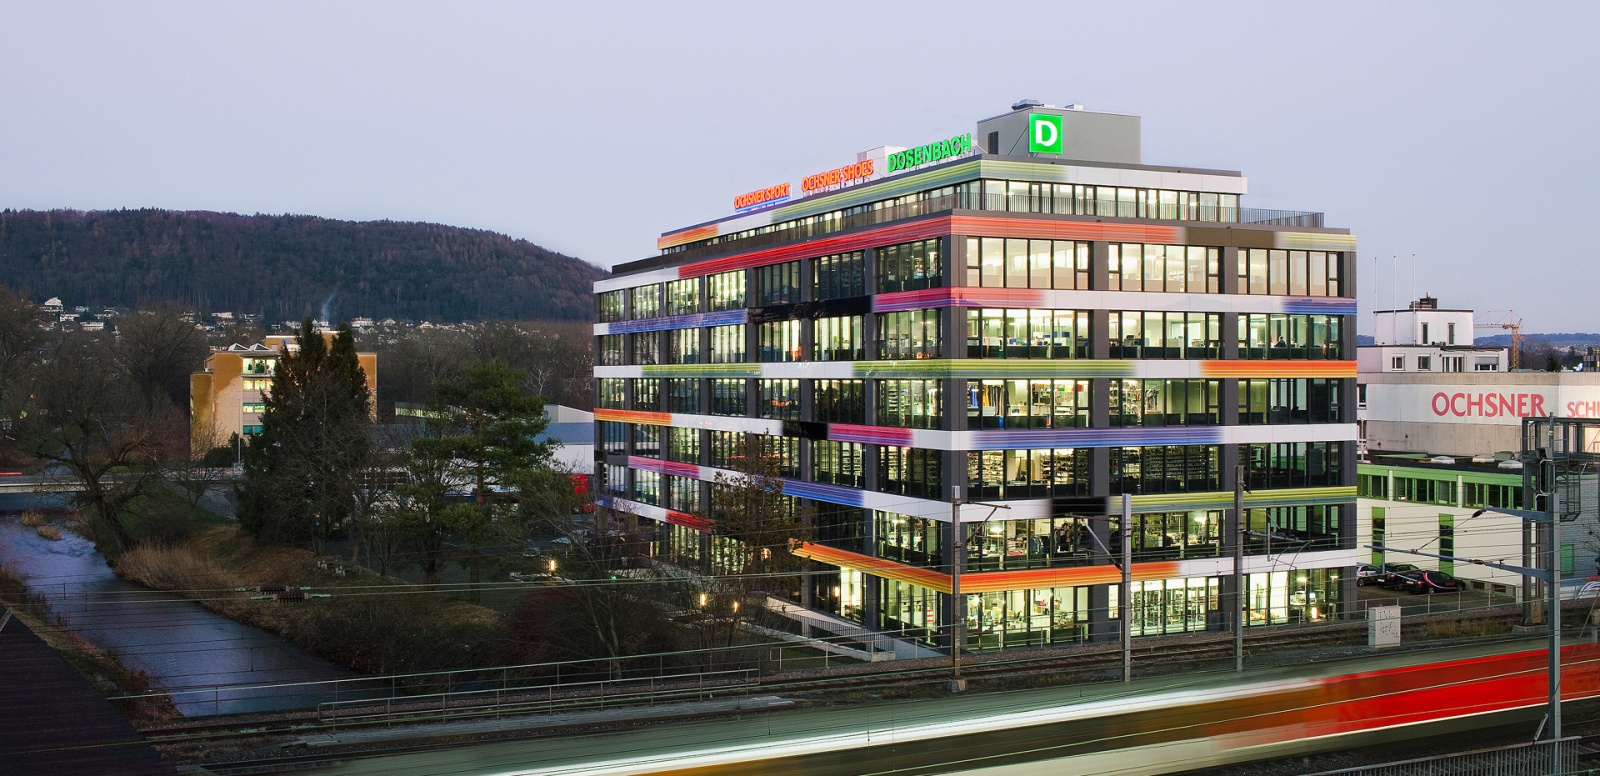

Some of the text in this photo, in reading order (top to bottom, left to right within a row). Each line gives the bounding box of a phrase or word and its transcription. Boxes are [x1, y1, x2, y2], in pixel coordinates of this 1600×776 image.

[1035, 119, 1058, 147] D
[887, 133, 971, 173] DOSENBACH
[801, 159, 874, 192] OCHSNER SHOES
[734, 182, 790, 209] OCHSNER SPORT
[1431, 392, 1548, 418] OCHSNER
